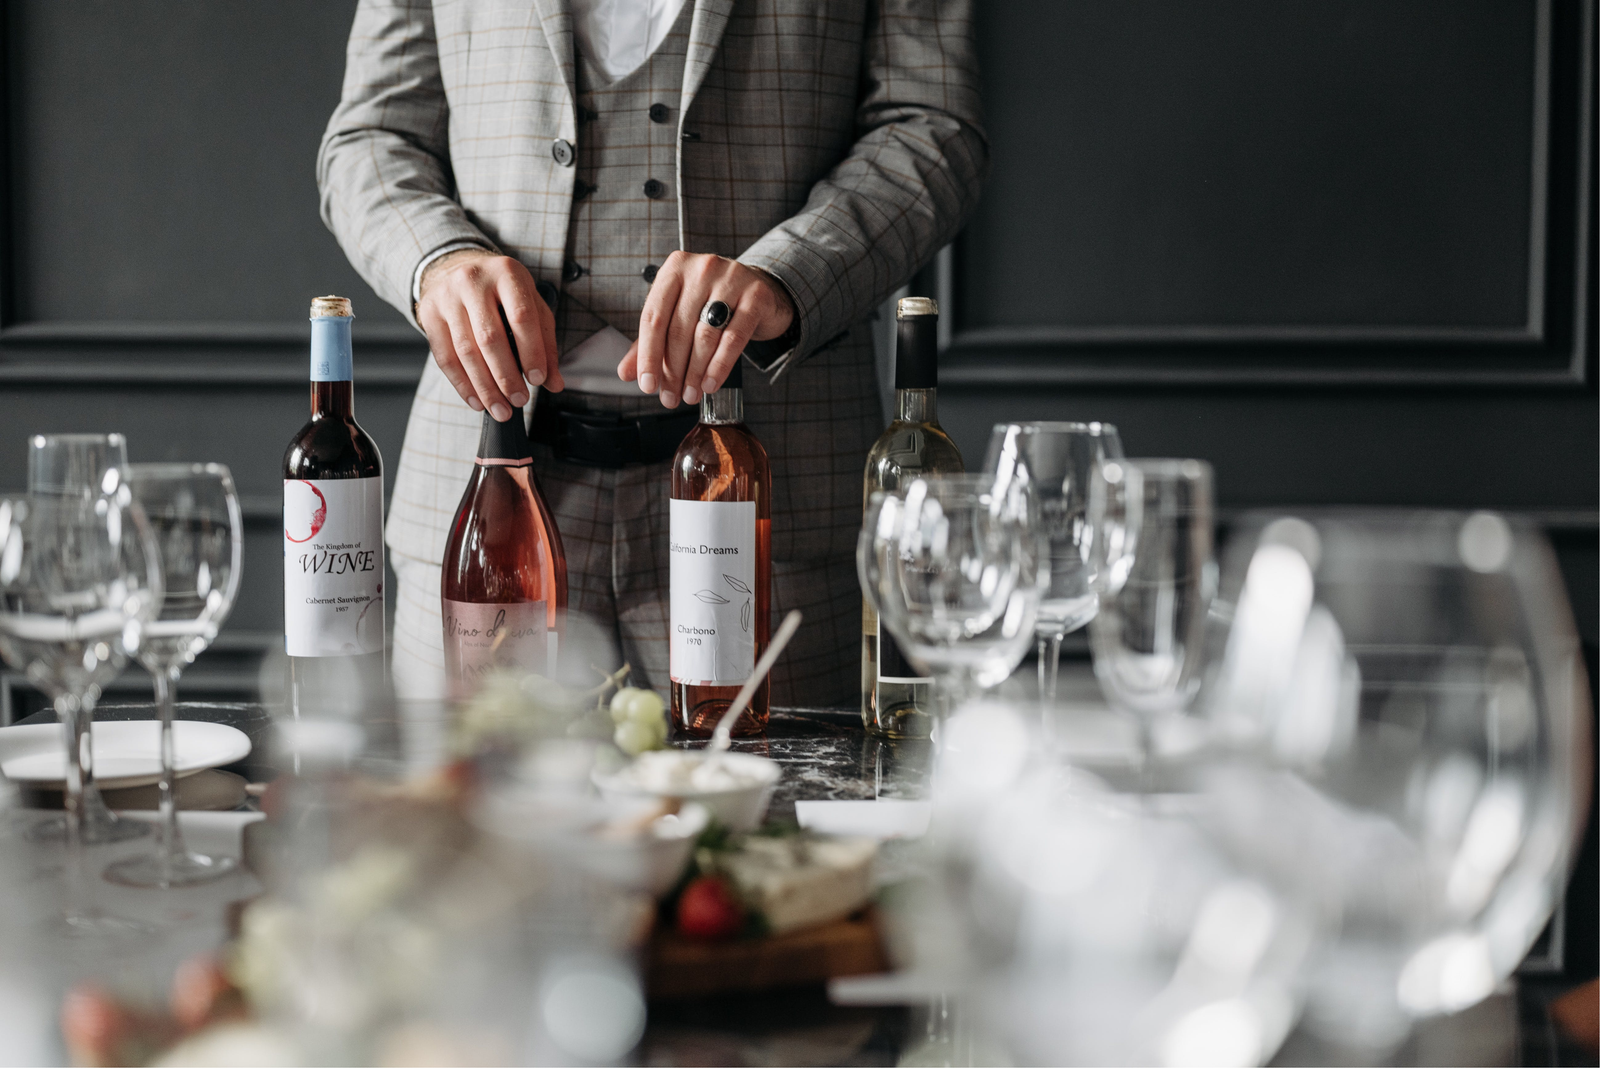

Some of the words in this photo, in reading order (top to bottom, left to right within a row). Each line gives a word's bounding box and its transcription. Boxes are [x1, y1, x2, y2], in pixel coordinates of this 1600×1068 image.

[326, 542, 354, 551] Kingdom
[354, 541, 361, 549] of
[699, 544, 739, 555] Dreams
[298, 550, 375, 575] WINE
[337, 595, 371, 604] Sauvignon
[446, 615, 482, 637] Vino
[677, 624, 716, 636] Charbono
[686, 638, 702, 646] 1970
